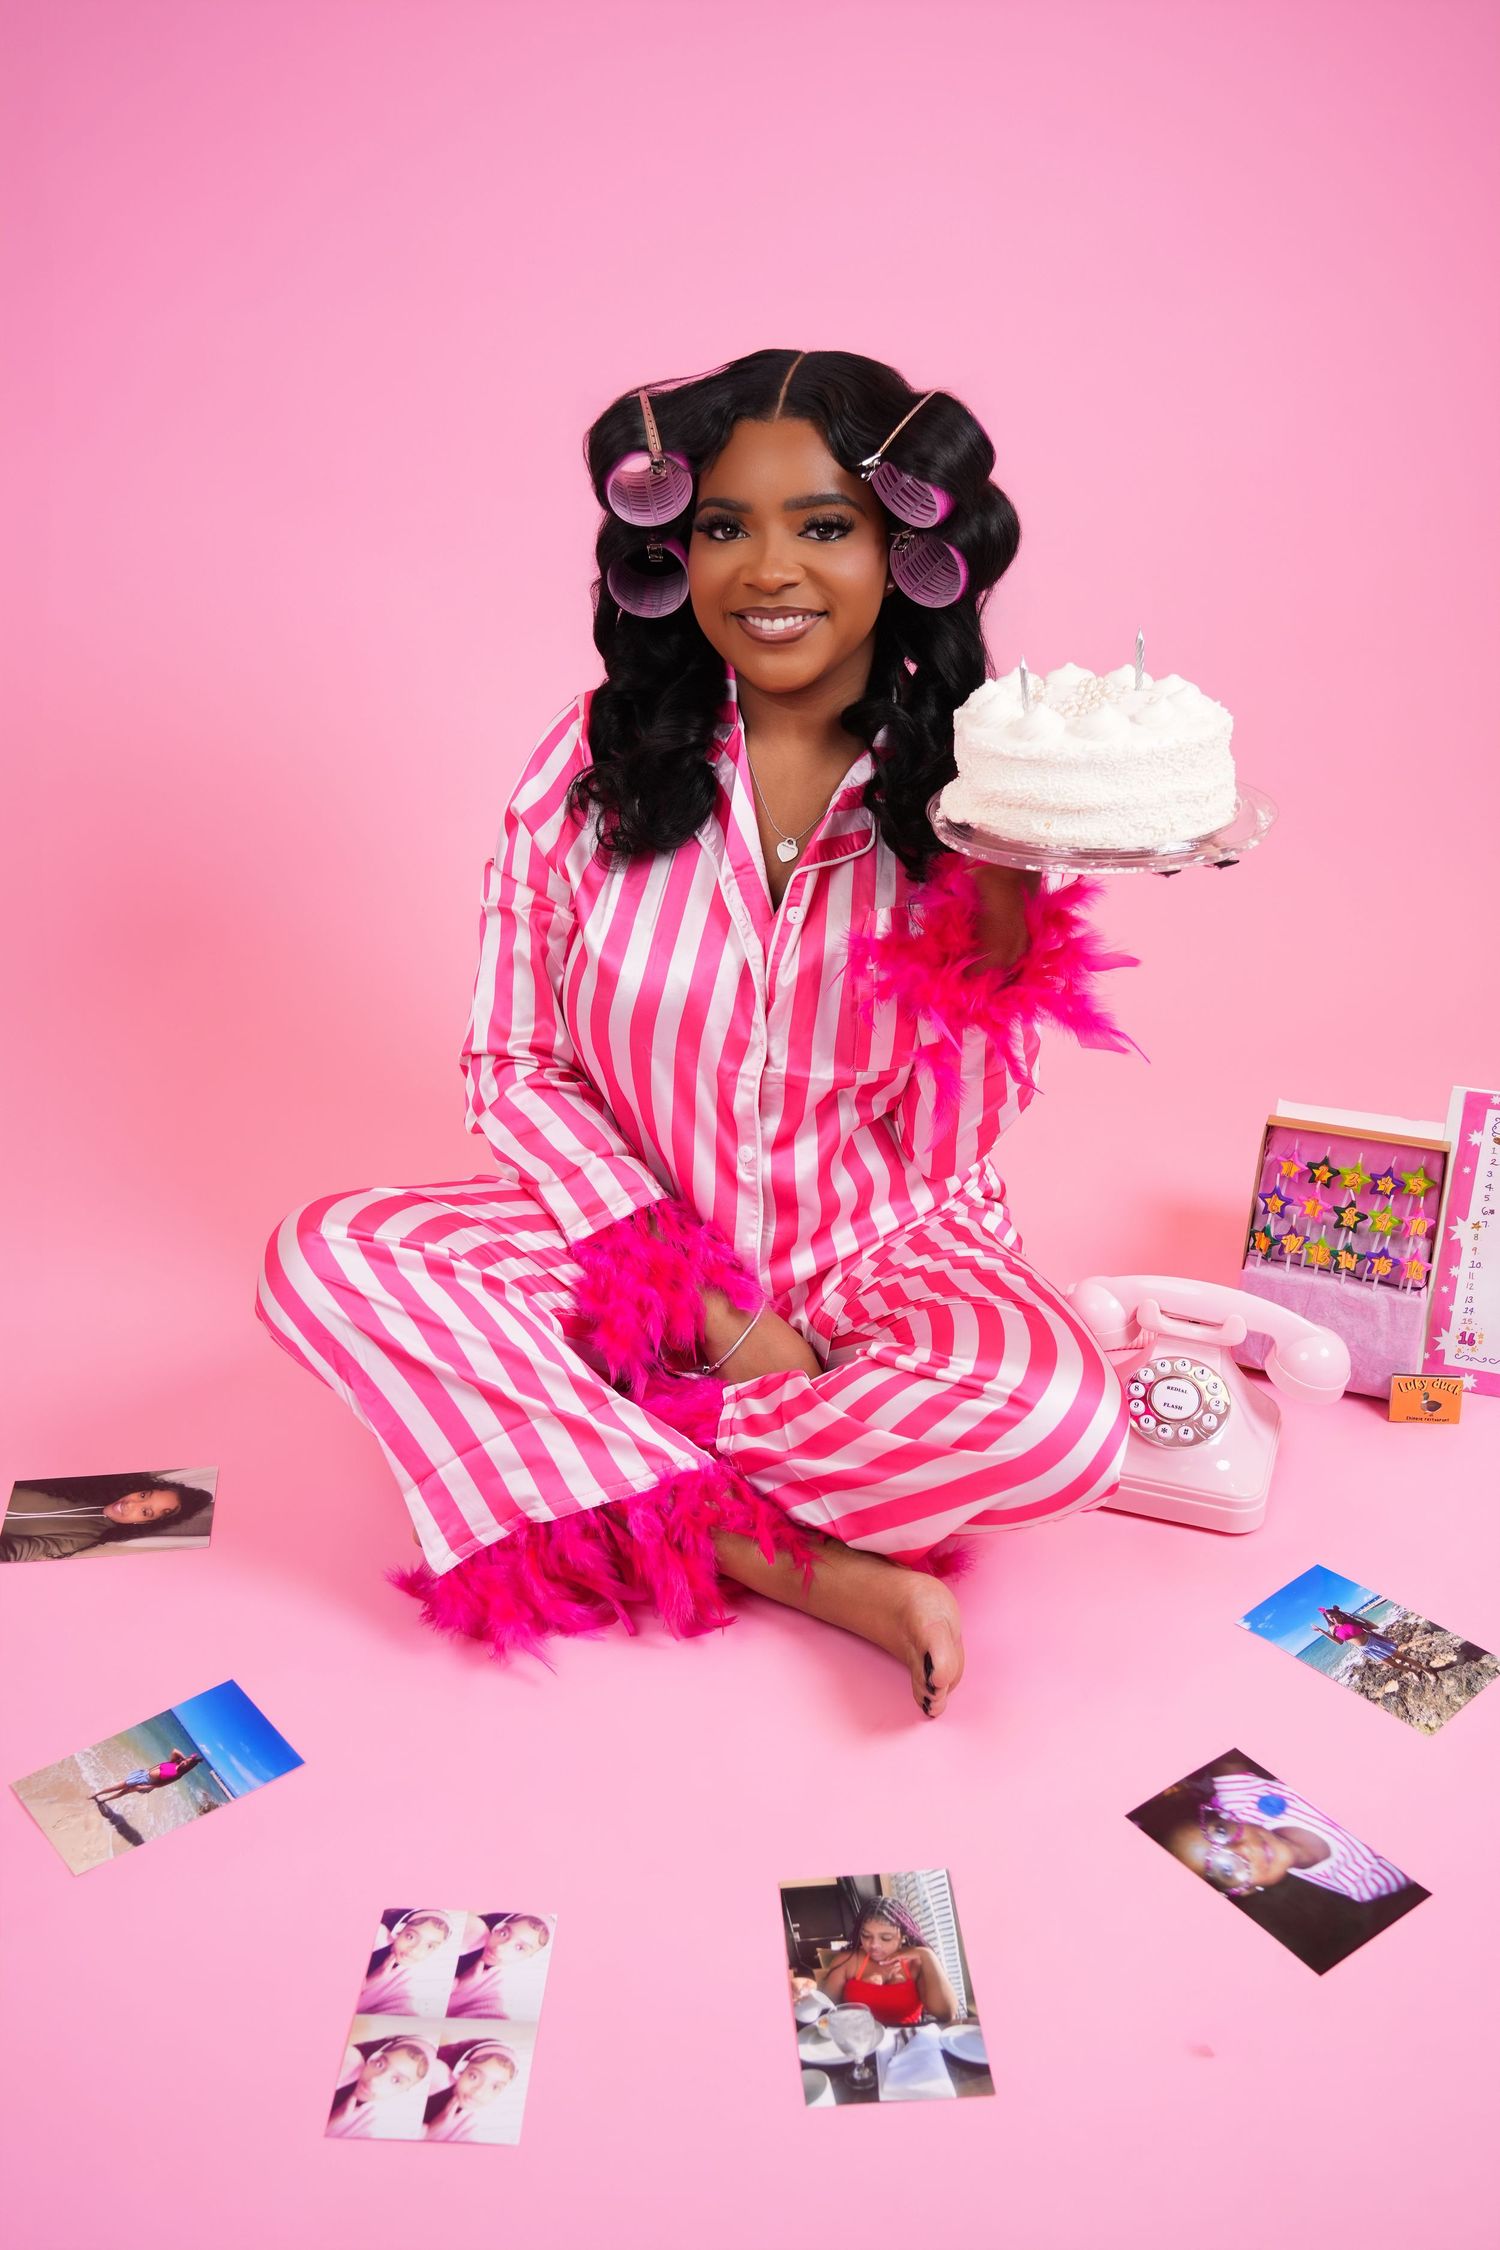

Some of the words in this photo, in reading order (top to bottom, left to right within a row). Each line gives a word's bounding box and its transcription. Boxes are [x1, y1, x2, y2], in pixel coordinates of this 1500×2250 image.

[1315, 1164, 1328, 1182] 2
[1344, 1172, 1361, 1188] 3
[1378, 1176, 1392, 1195] 4
[1409, 1177, 1424, 1194] 5
[1268, 1193, 1279, 1214] 6
[1345, 1207, 1358, 1226] 8
[1376, 1213, 1390, 1232] 9
[1410, 1219, 1428, 1236] 10
[1473, 1233, 1479, 1241] 8
[1281, 1234, 1305, 1254] 12
[1311, 1245, 1331, 1266] 13
[1338, 1250, 1358, 1271] 14
[1372, 1257, 1393, 1276] 15
[1405, 1261, 1424, 1280] 16
[1458, 1331, 1476, 1346] 16
[1166, 1385, 1188, 1394] REDIAL
[1163, 1402, 1183, 1411] FLASH
